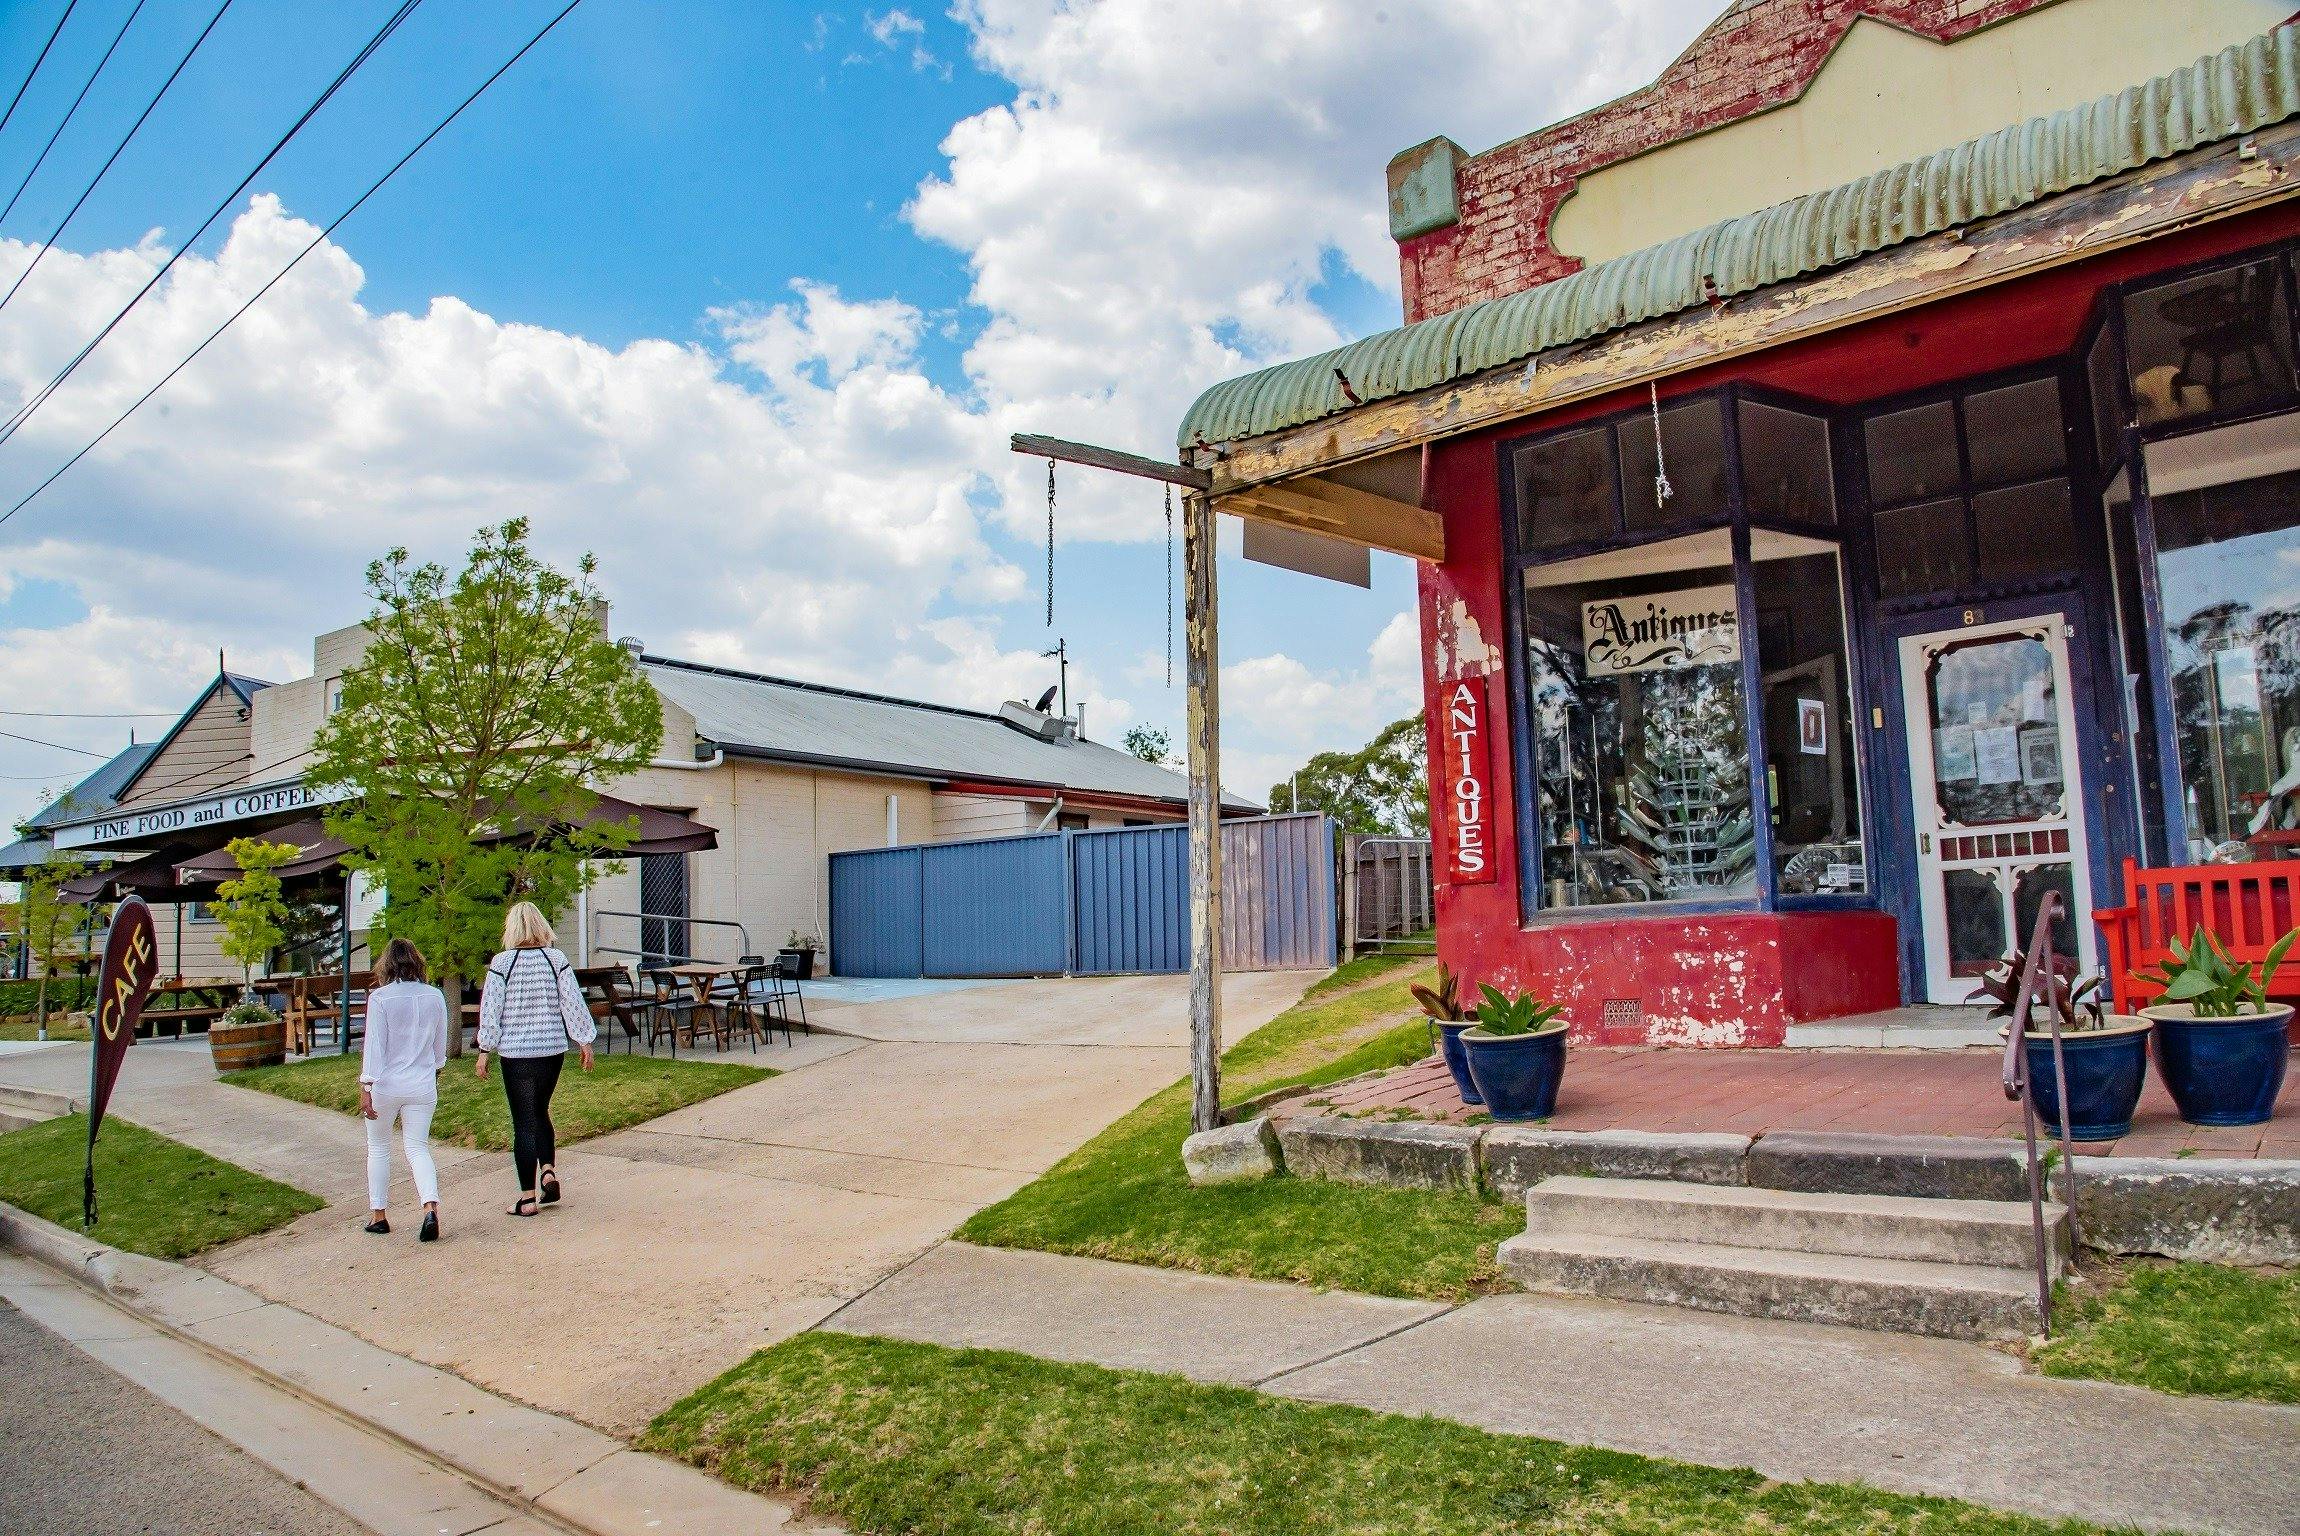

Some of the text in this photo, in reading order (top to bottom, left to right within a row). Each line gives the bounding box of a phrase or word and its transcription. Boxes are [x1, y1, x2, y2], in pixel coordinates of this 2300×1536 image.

[1588, 603, 1737, 660] Antiques
[93, 787, 316, 841] FINE FOOD and COFFEE
[1450, 683, 1485, 872] ANTIQUES
[102, 922, 151, 1041] CAFE
